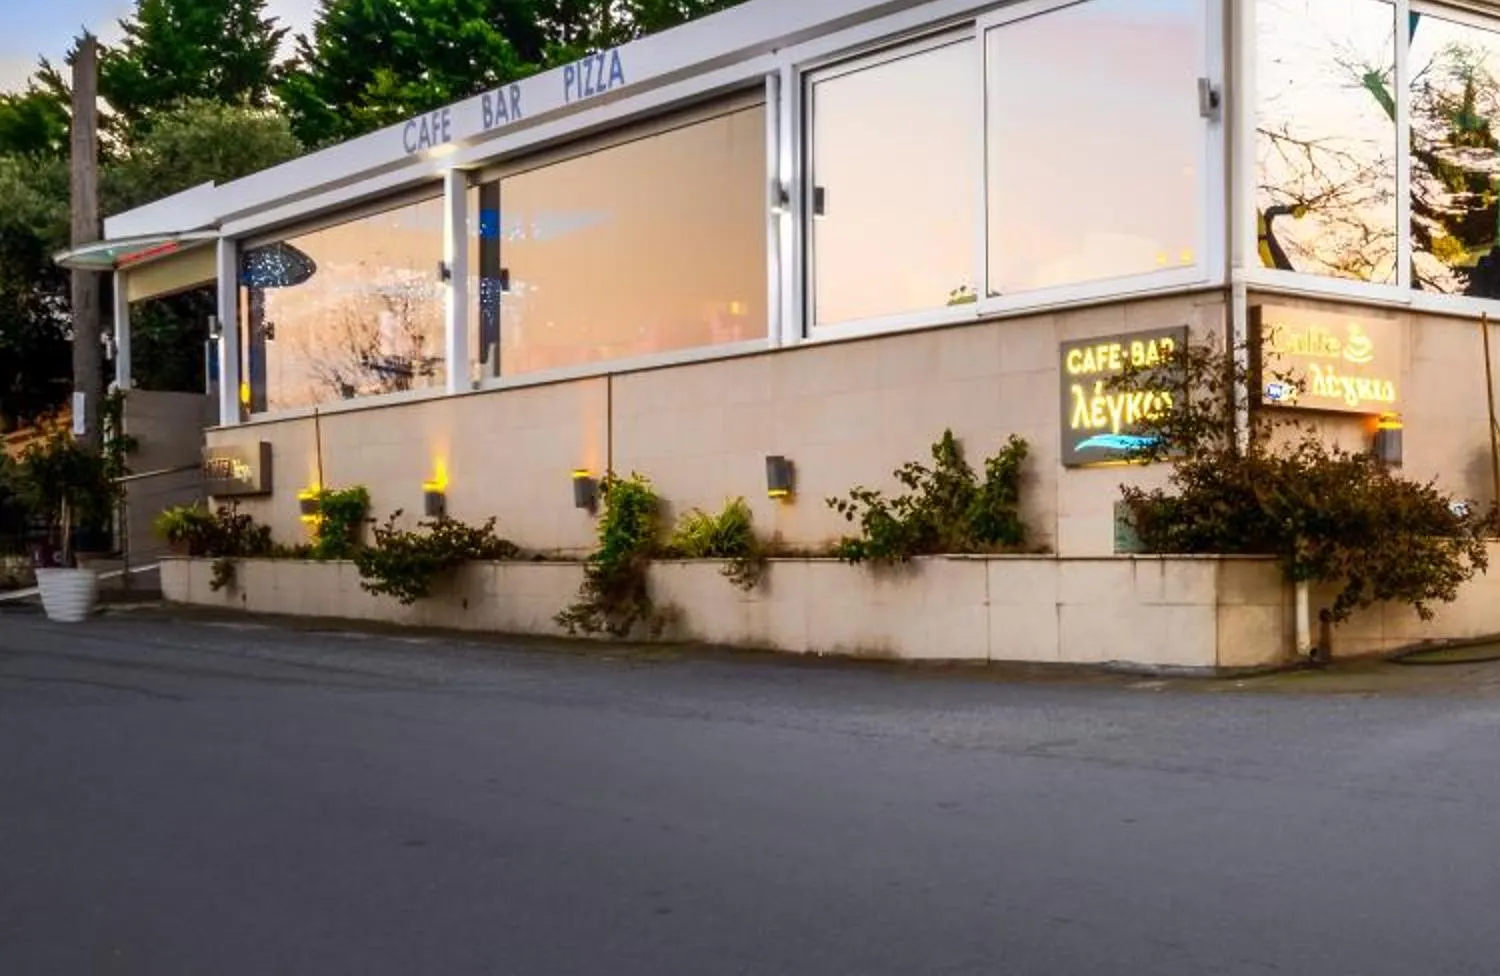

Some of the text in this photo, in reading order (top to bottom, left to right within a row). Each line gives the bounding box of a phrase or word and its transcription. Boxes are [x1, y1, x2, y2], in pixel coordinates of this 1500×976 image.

[403, 49, 625, 153] CAFE BAR PIZZA
